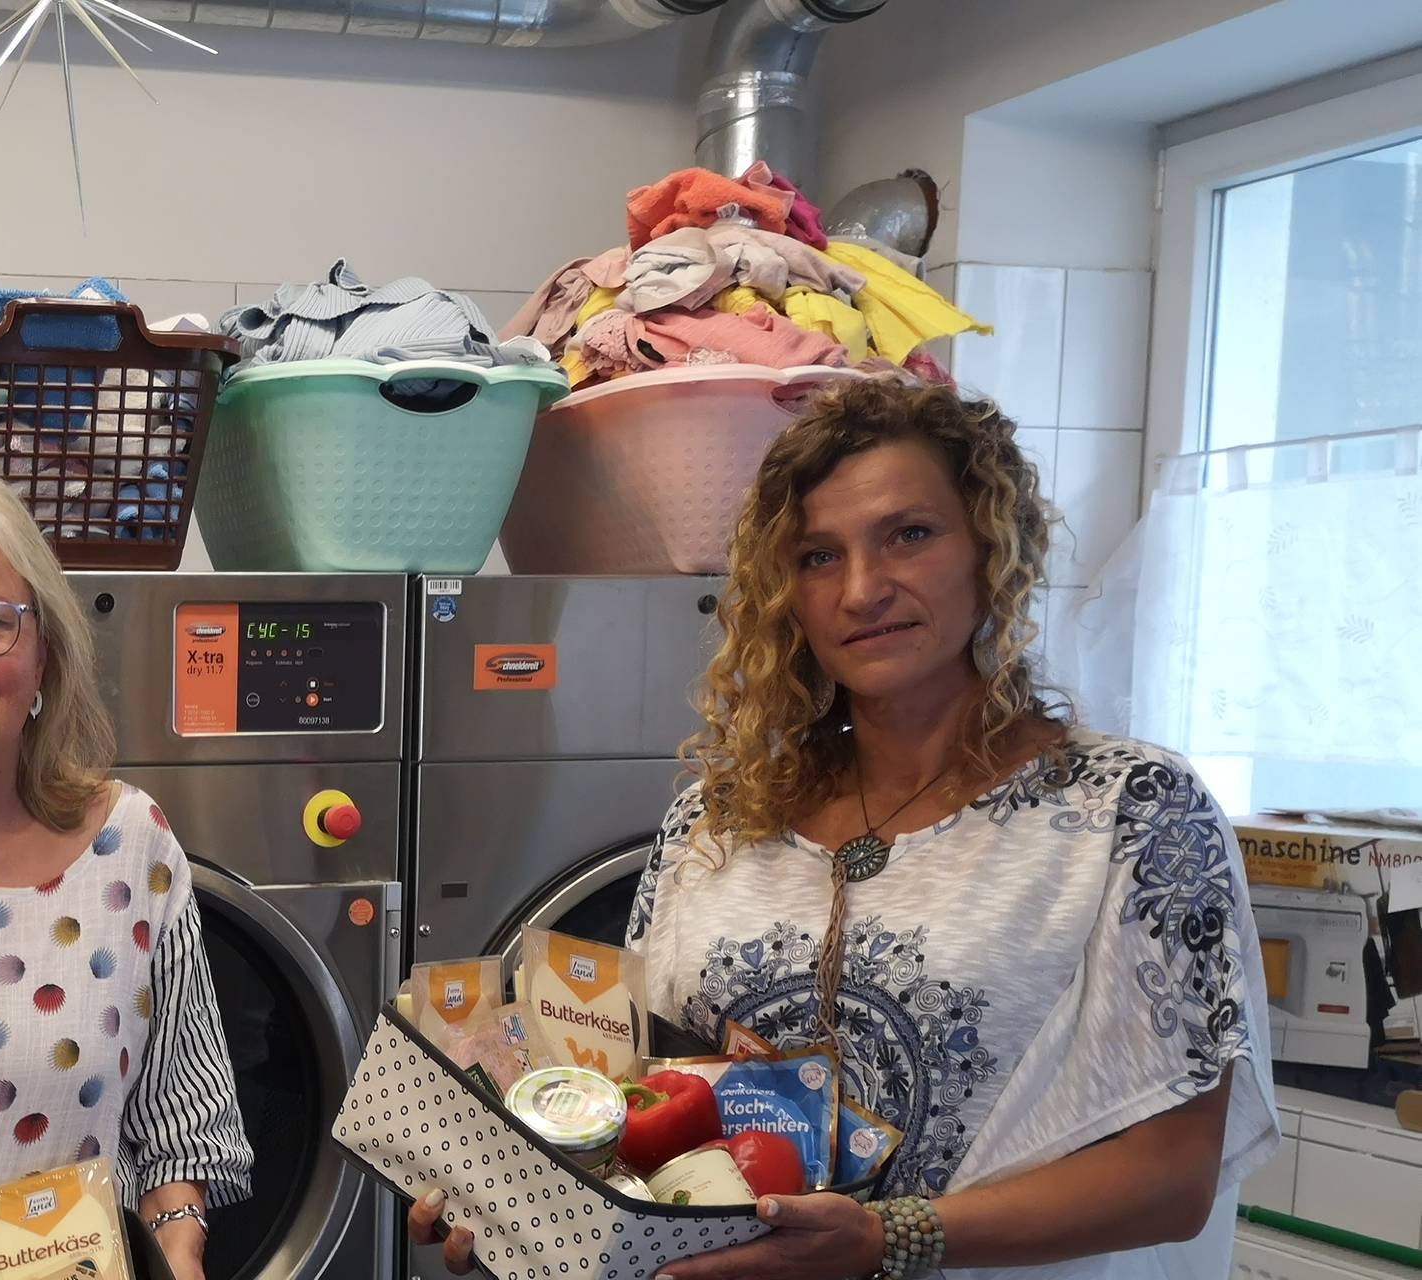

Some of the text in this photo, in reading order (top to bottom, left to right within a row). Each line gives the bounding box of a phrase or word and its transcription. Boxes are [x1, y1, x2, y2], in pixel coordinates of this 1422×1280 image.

[187, 650, 224, 664] X-tra
[187, 665, 224, 677] dry 11.7
[1238, 836, 1361, 866] maschine
[540, 999, 630, 1037] Butterkäse
